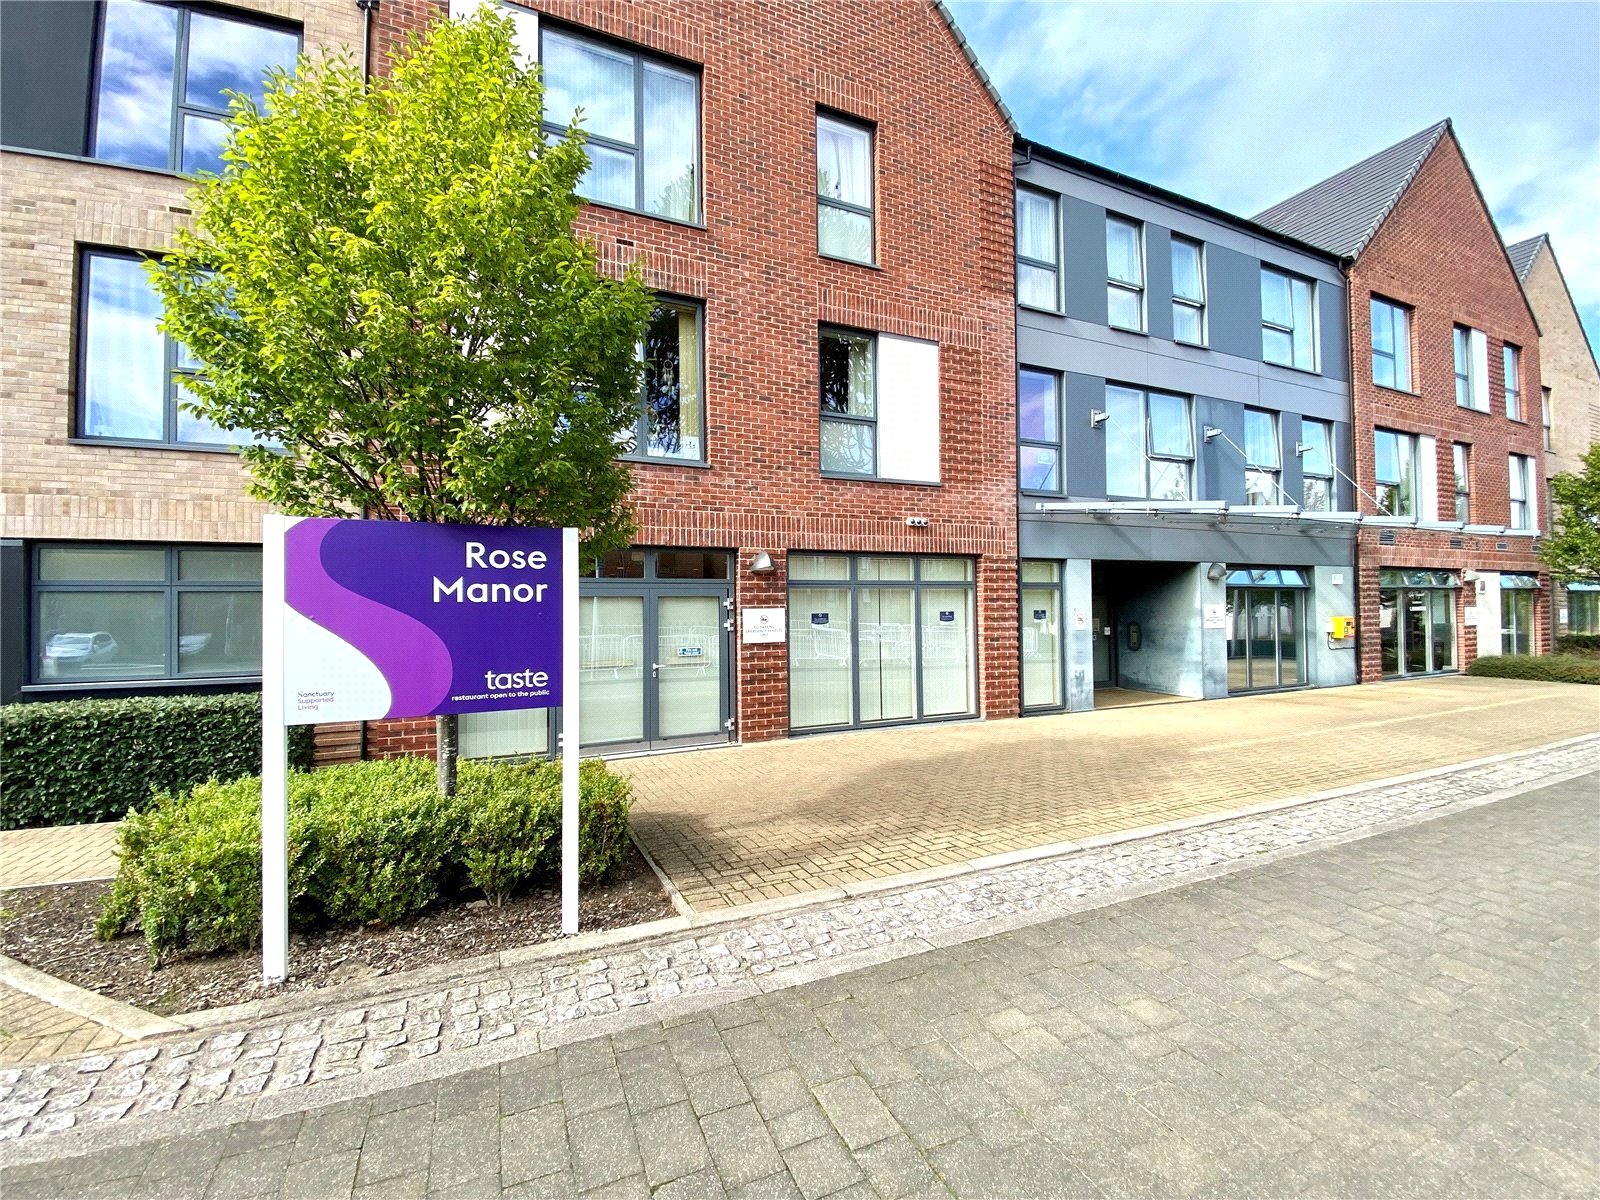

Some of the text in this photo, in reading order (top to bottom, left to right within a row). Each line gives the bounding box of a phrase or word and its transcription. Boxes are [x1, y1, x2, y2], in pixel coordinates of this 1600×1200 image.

[466, 542, 547, 569] Rose
[433, 575, 548, 603] Manor
[484, 668, 549, 690] taste
[451, 693, 488, 701] restaurant
[489, 692, 507, 700] open
[529, 689, 550, 697] public
